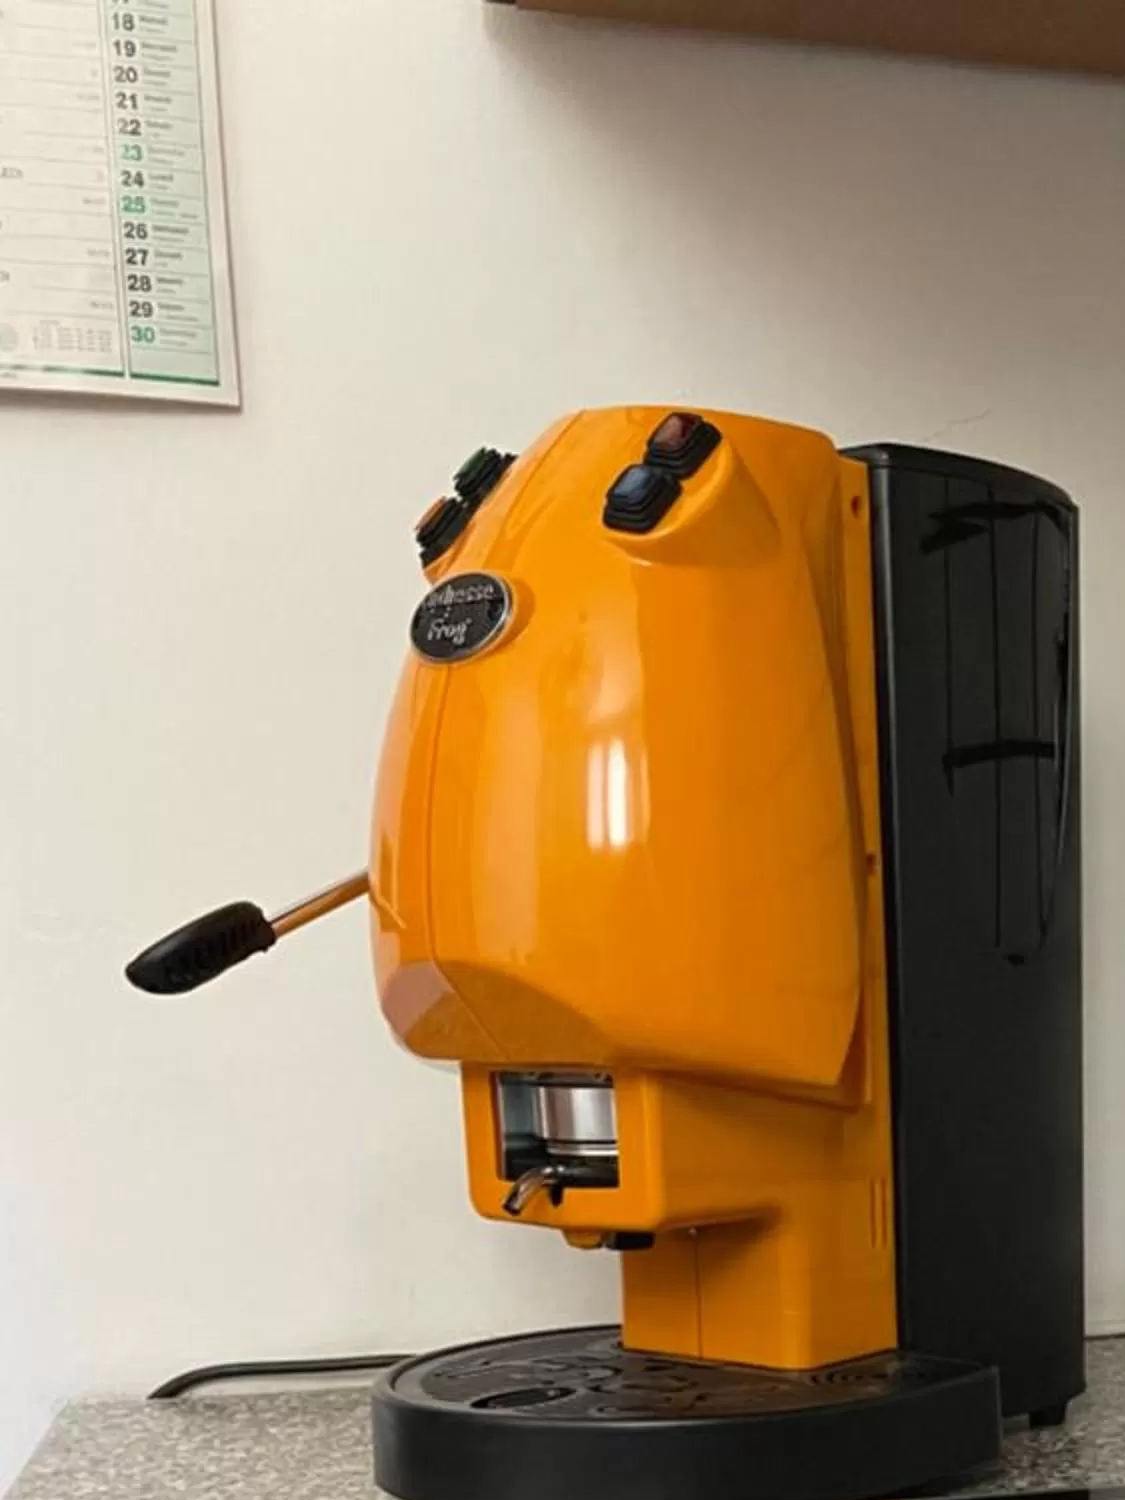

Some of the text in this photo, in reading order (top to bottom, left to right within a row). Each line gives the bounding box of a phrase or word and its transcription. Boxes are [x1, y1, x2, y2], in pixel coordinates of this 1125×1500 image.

[112, 12, 136, 31] 18
[113, 39, 136, 57] 19
[113, 66, 139, 83] 20
[115, 91, 139, 110] 21
[117, 117, 142, 136] 22
[121, 143, 143, 161] 23
[121, 169, 145, 188] 24
[123, 221, 148, 240] 26
[125, 247, 149, 266] 27
[127, 274, 152, 292] 28
[128, 300, 153, 318] 29
[131, 326, 155, 343] 30
